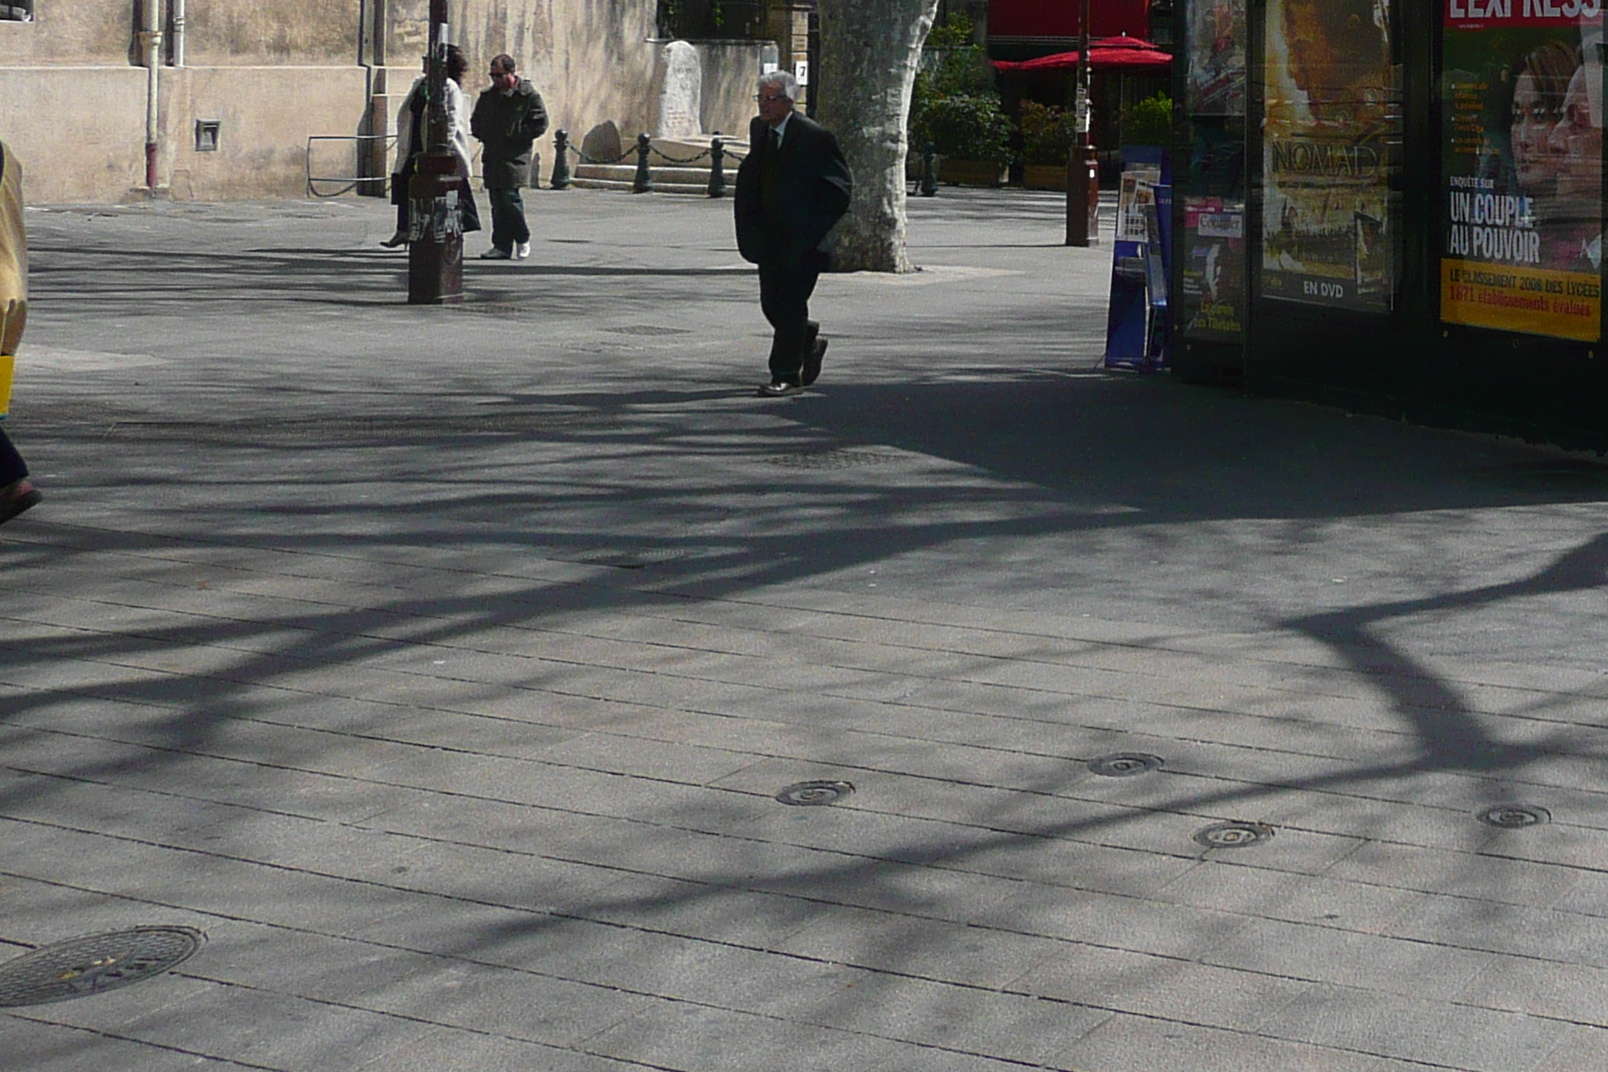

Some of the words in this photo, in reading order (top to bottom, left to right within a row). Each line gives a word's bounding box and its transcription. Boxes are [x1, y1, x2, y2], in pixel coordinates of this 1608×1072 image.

[1272, 140, 1378, 176] NOMAD
[1450, 191, 1470, 222] UN
[1473, 193, 1534, 228] COUPLE
[1450, 224, 1470, 256] AU
[1472, 226, 1541, 263] POUVOIR
[1303, 280, 1318, 294] EN
[1320, 282, 1344, 298] DVD
[1545, 279, 1563, 294] DES
